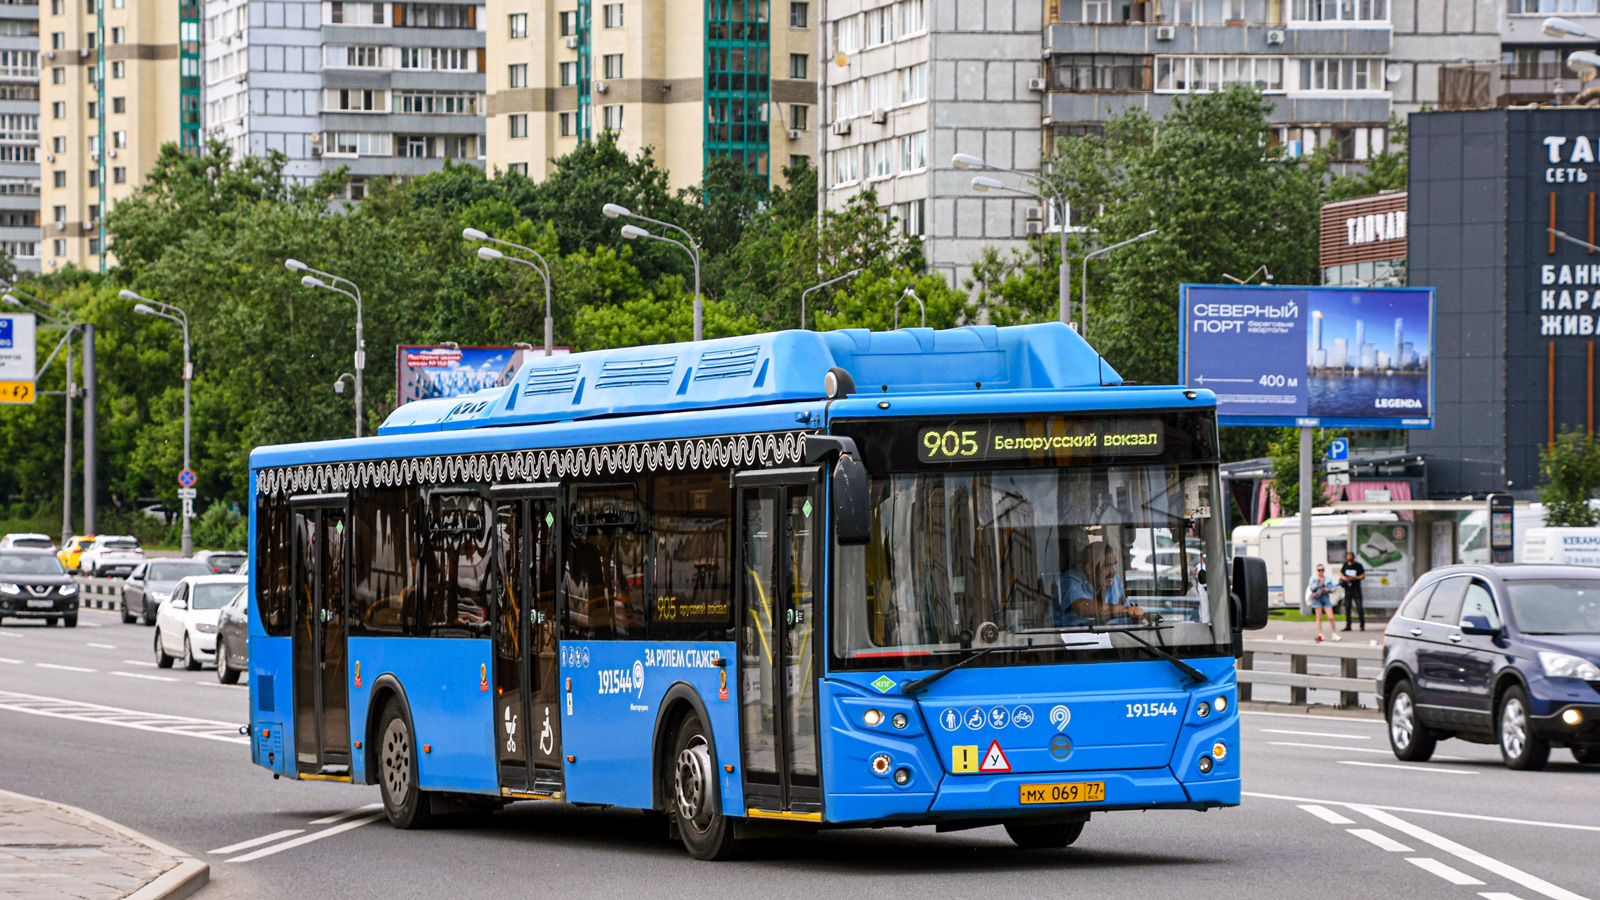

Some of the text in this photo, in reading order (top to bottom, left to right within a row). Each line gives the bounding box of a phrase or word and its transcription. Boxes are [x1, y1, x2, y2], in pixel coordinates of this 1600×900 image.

[1543, 135, 1600, 164] ТА
[1546, 167, 1588, 183] СЕТЬ
[1346, 211, 1406, 246] ТАПЧАН
[1193, 300, 1298, 318] СЕВЕРНЫЙ
[1194, 320, 1244, 333] ПОРТ
[1259, 375, 1298, 387] 400 м
[1375, 398, 1423, 409] LEGENDA
[923, 431, 1158, 457] 905 Белорусский вокзал
[657, 596, 677, 620] 905
[645, 649, 656, 667] ЗА
[656, 649, 685, 668] РУЛЕМ
[598, 669, 632, 694] 191544
[1126, 703, 1178, 718] 191544
[1051, 785, 1078, 801] 069
[1086, 783, 1100, 795] 77
